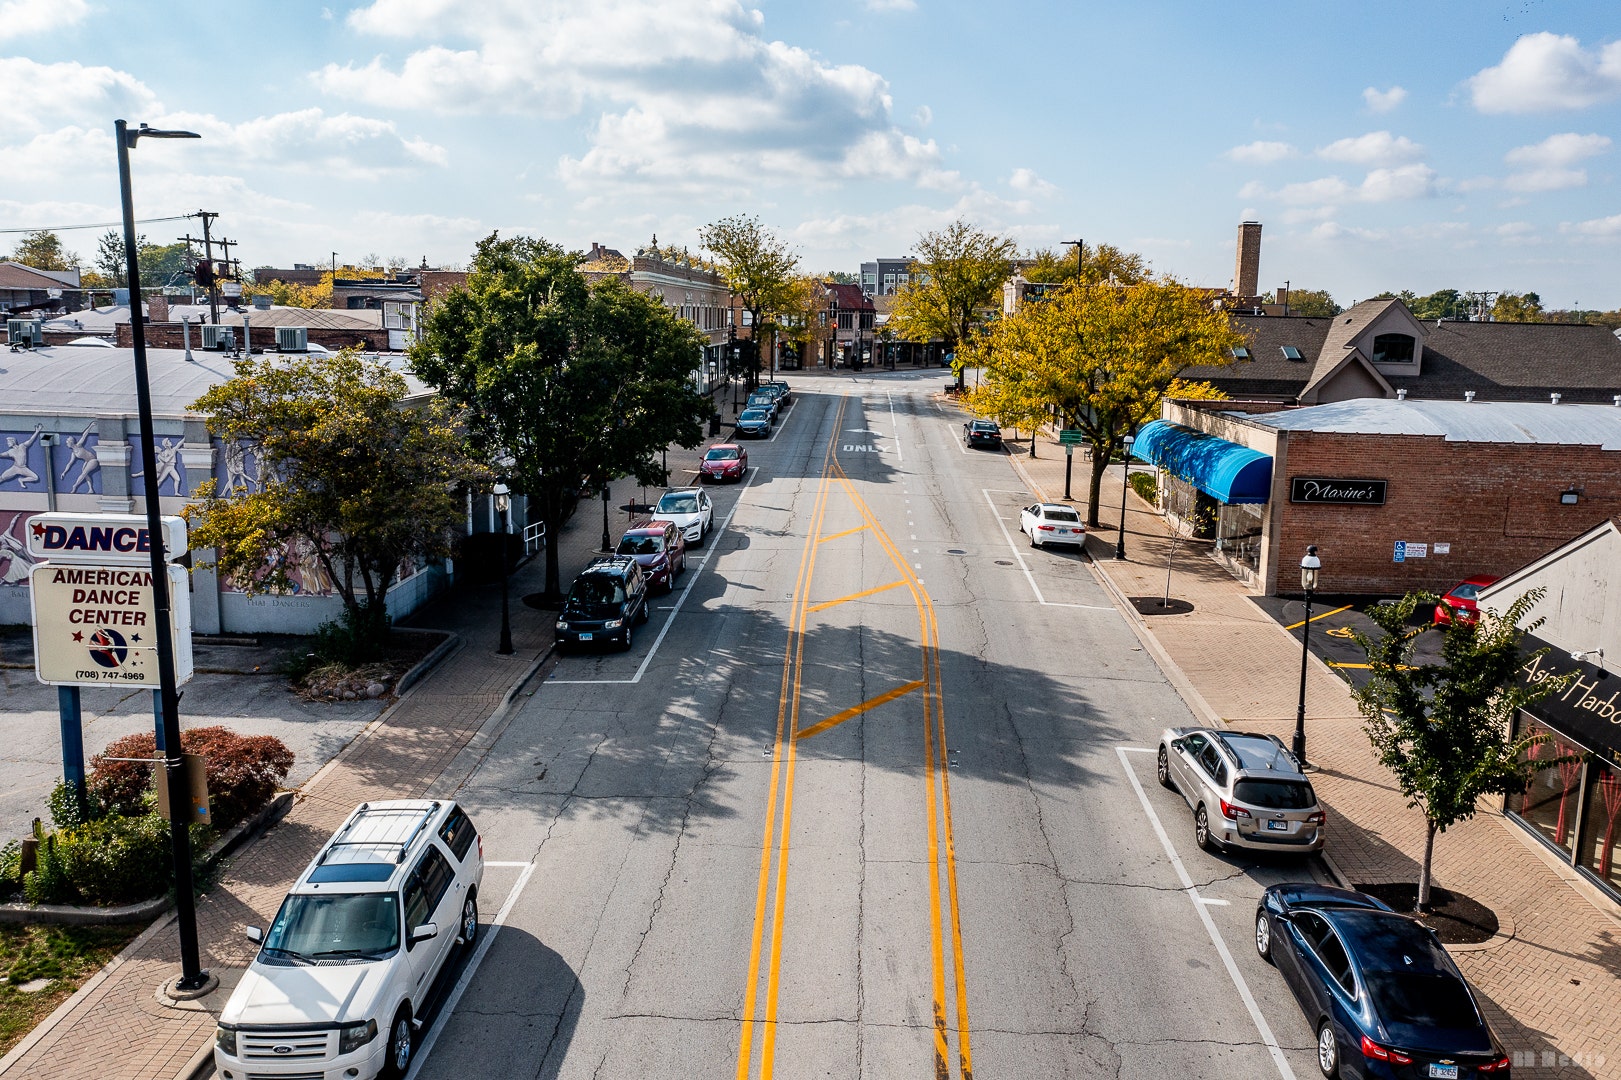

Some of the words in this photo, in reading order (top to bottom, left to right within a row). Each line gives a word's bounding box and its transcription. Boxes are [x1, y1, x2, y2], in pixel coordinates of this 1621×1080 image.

[843, 444, 892, 453] ONLY
[1303, 480, 1376, 501] Maxine's
[43, 525, 151, 553] DANCE
[52, 569, 154, 587] AMERICAN
[72, 589, 141, 606] DANCE
[69, 609, 147, 626] CENTER
[75, 670, 99, 680] (708)
[102, 671, 145, 680] 747-4969
